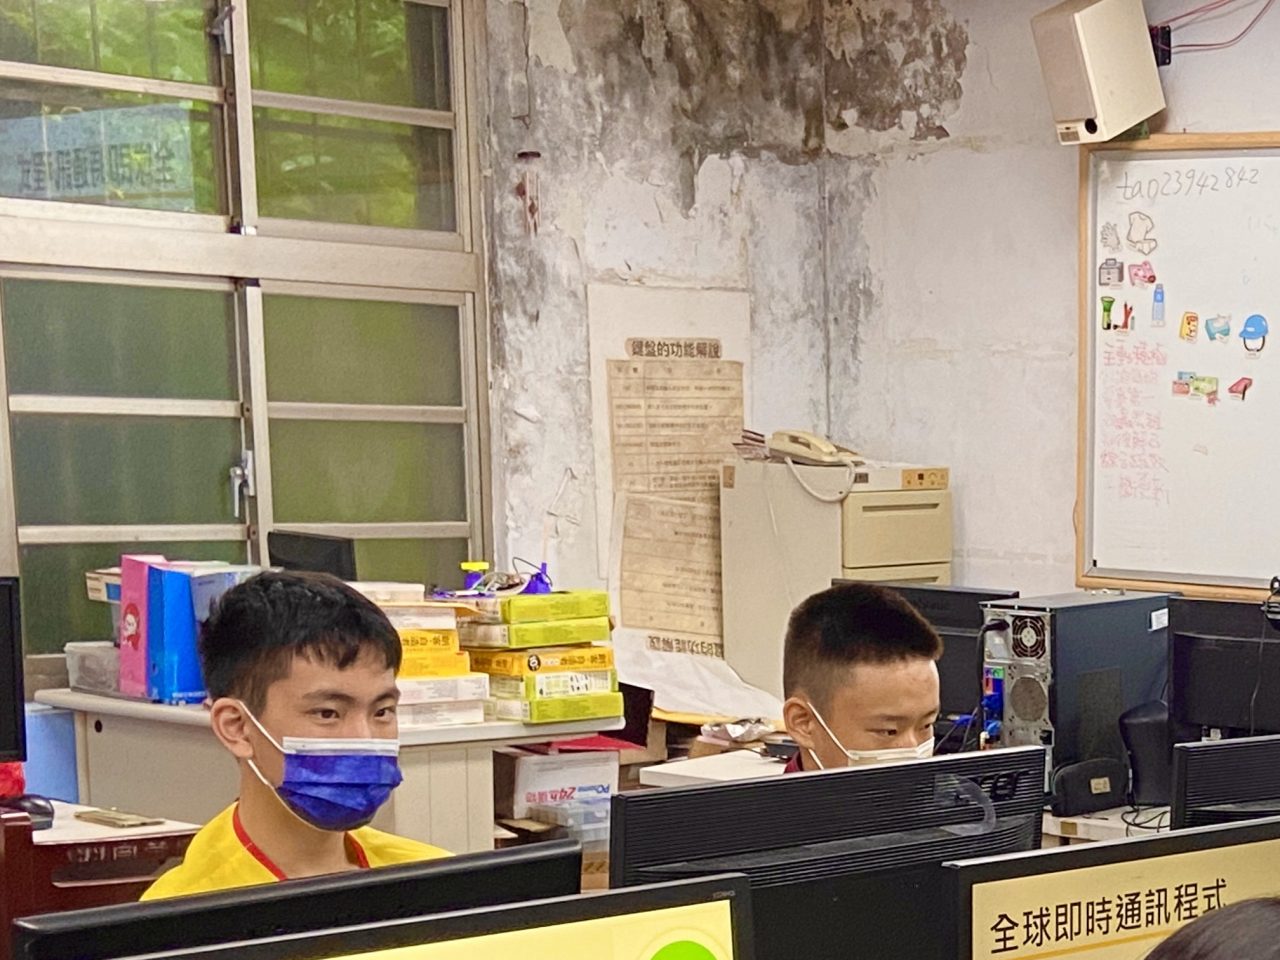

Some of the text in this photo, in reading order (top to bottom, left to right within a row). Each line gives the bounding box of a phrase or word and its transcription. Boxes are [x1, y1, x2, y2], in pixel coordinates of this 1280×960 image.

[990, 878, 1227, 954] 全球即時通訊程式
